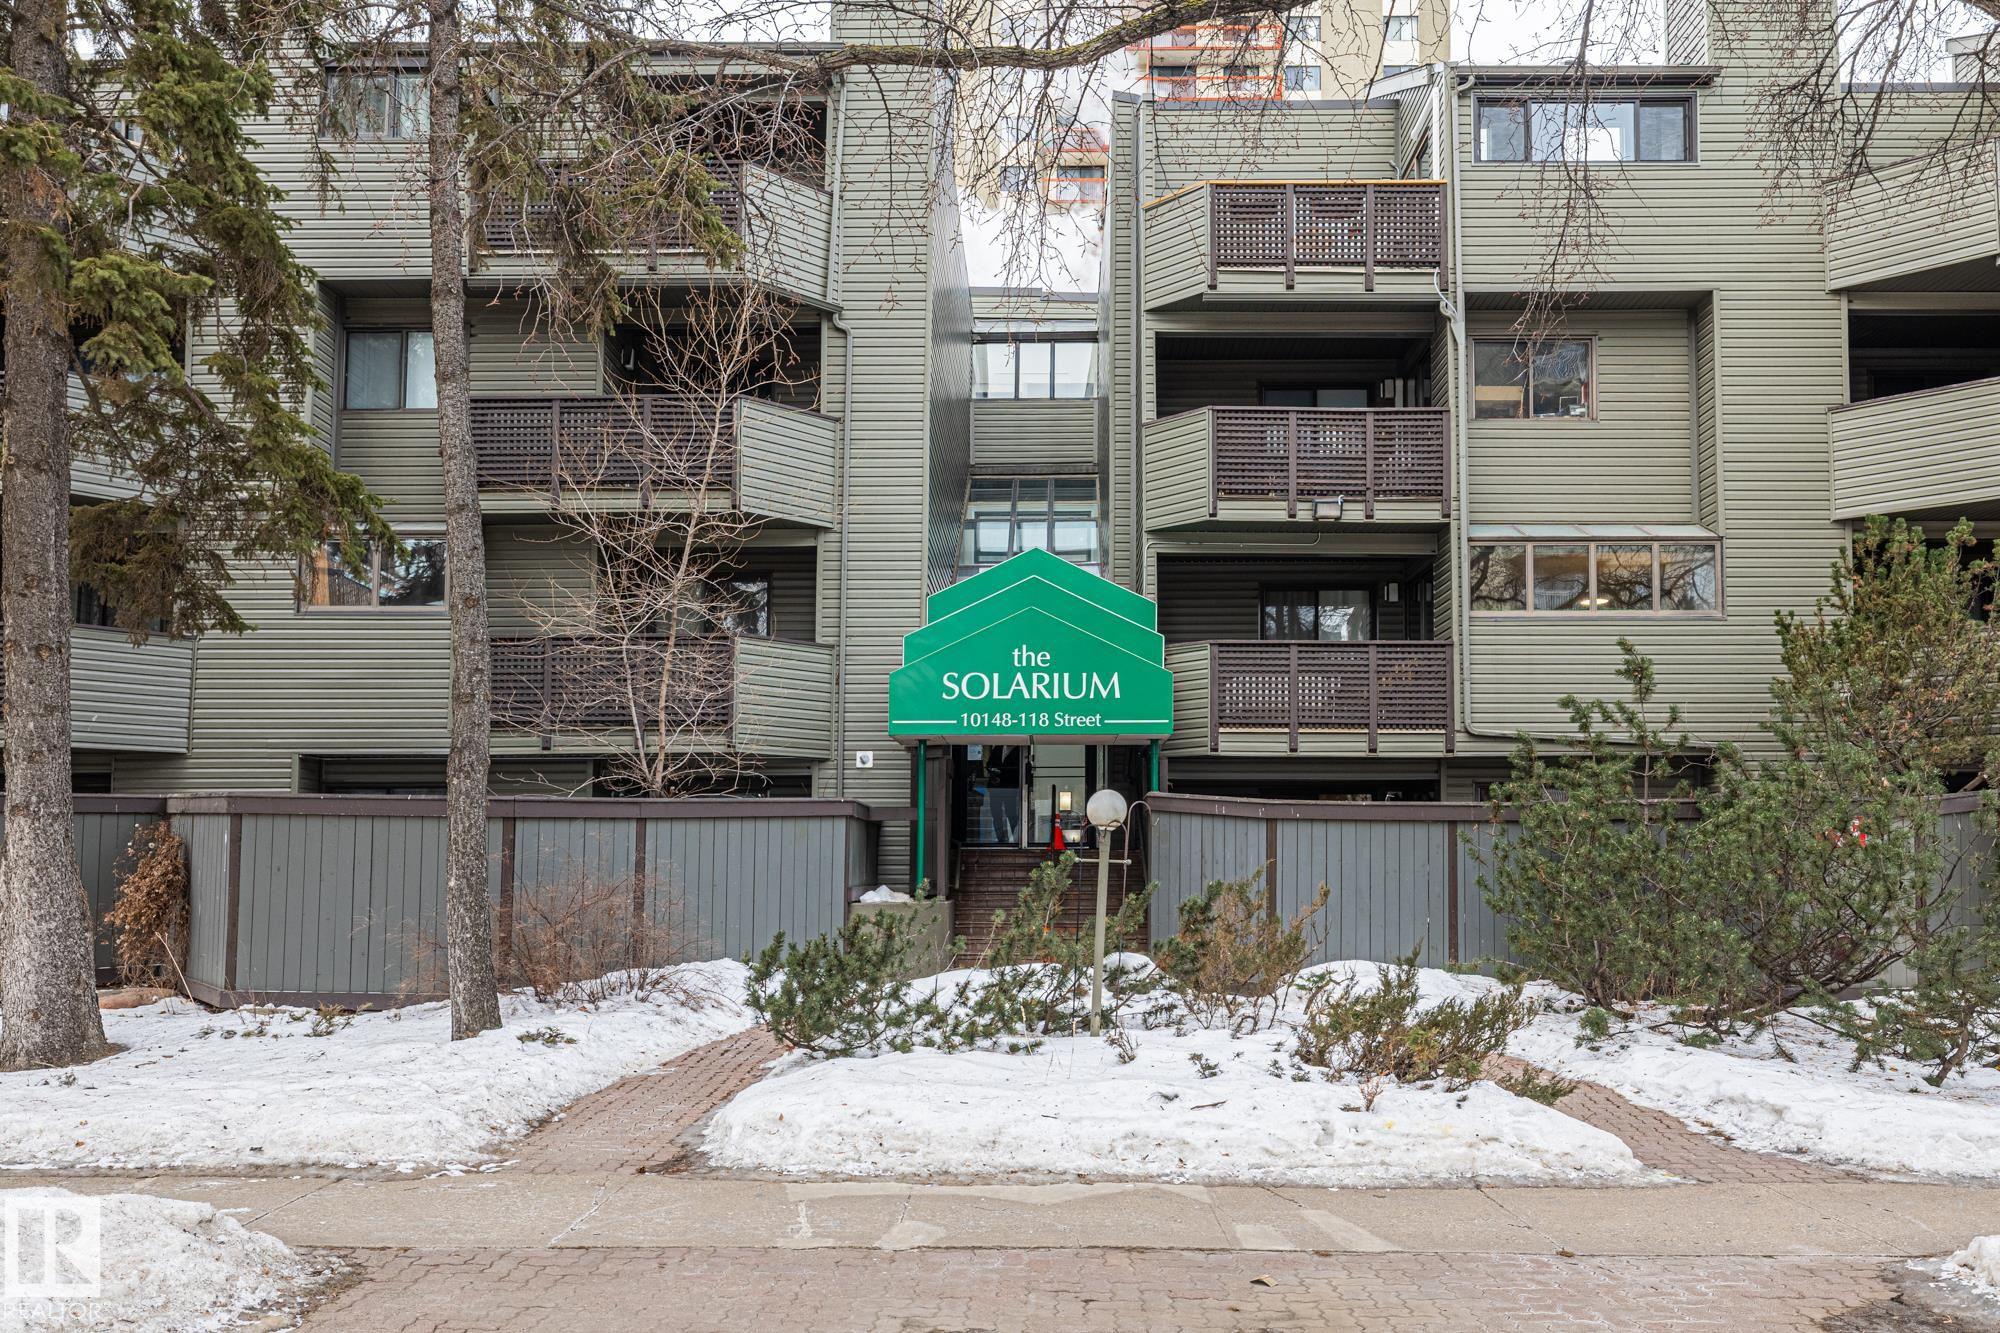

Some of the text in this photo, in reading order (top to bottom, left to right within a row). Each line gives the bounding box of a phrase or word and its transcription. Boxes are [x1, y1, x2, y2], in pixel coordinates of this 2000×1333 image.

[1012, 644, 1051, 667] the
[942, 671, 1121, 700] SOLARIUM
[961, 711, 1102, 727] 10148-118 Street
